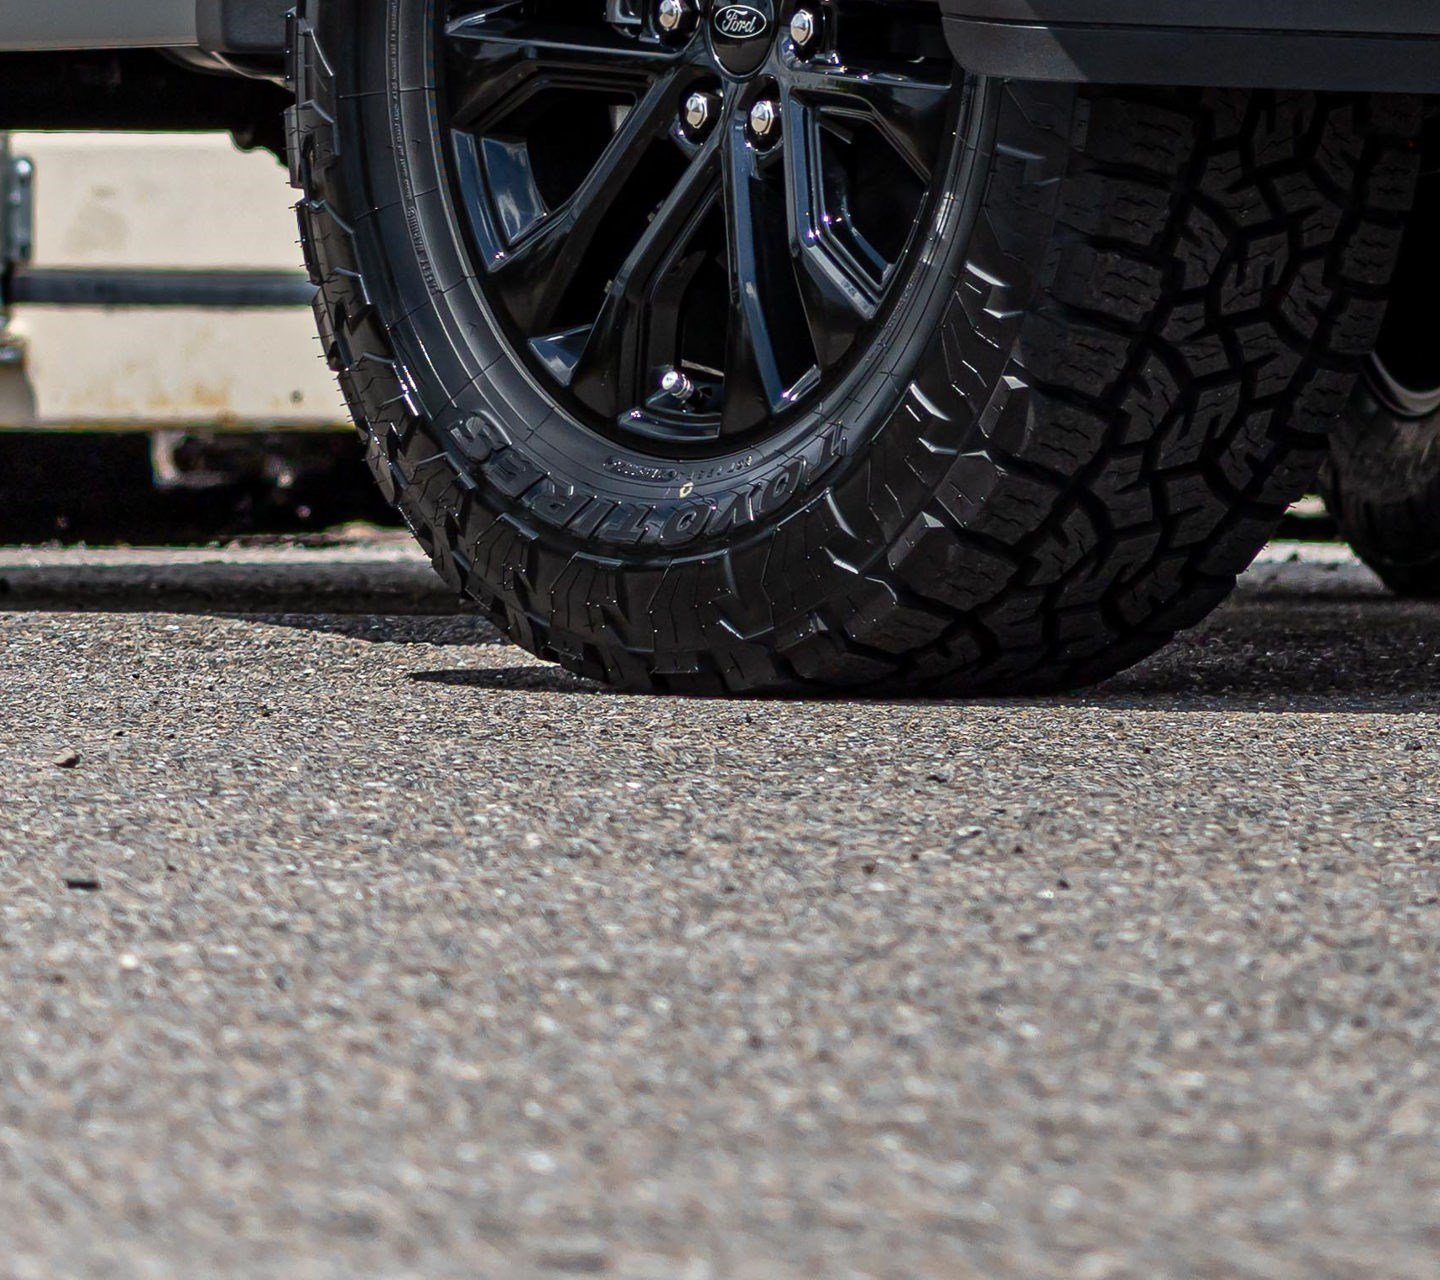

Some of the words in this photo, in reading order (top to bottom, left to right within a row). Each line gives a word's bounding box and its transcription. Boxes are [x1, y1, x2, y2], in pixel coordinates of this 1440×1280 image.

[721, 8, 757, 33] Ford
[448, 409, 658, 542] TIRES
[660, 421, 848, 541] TOYO
